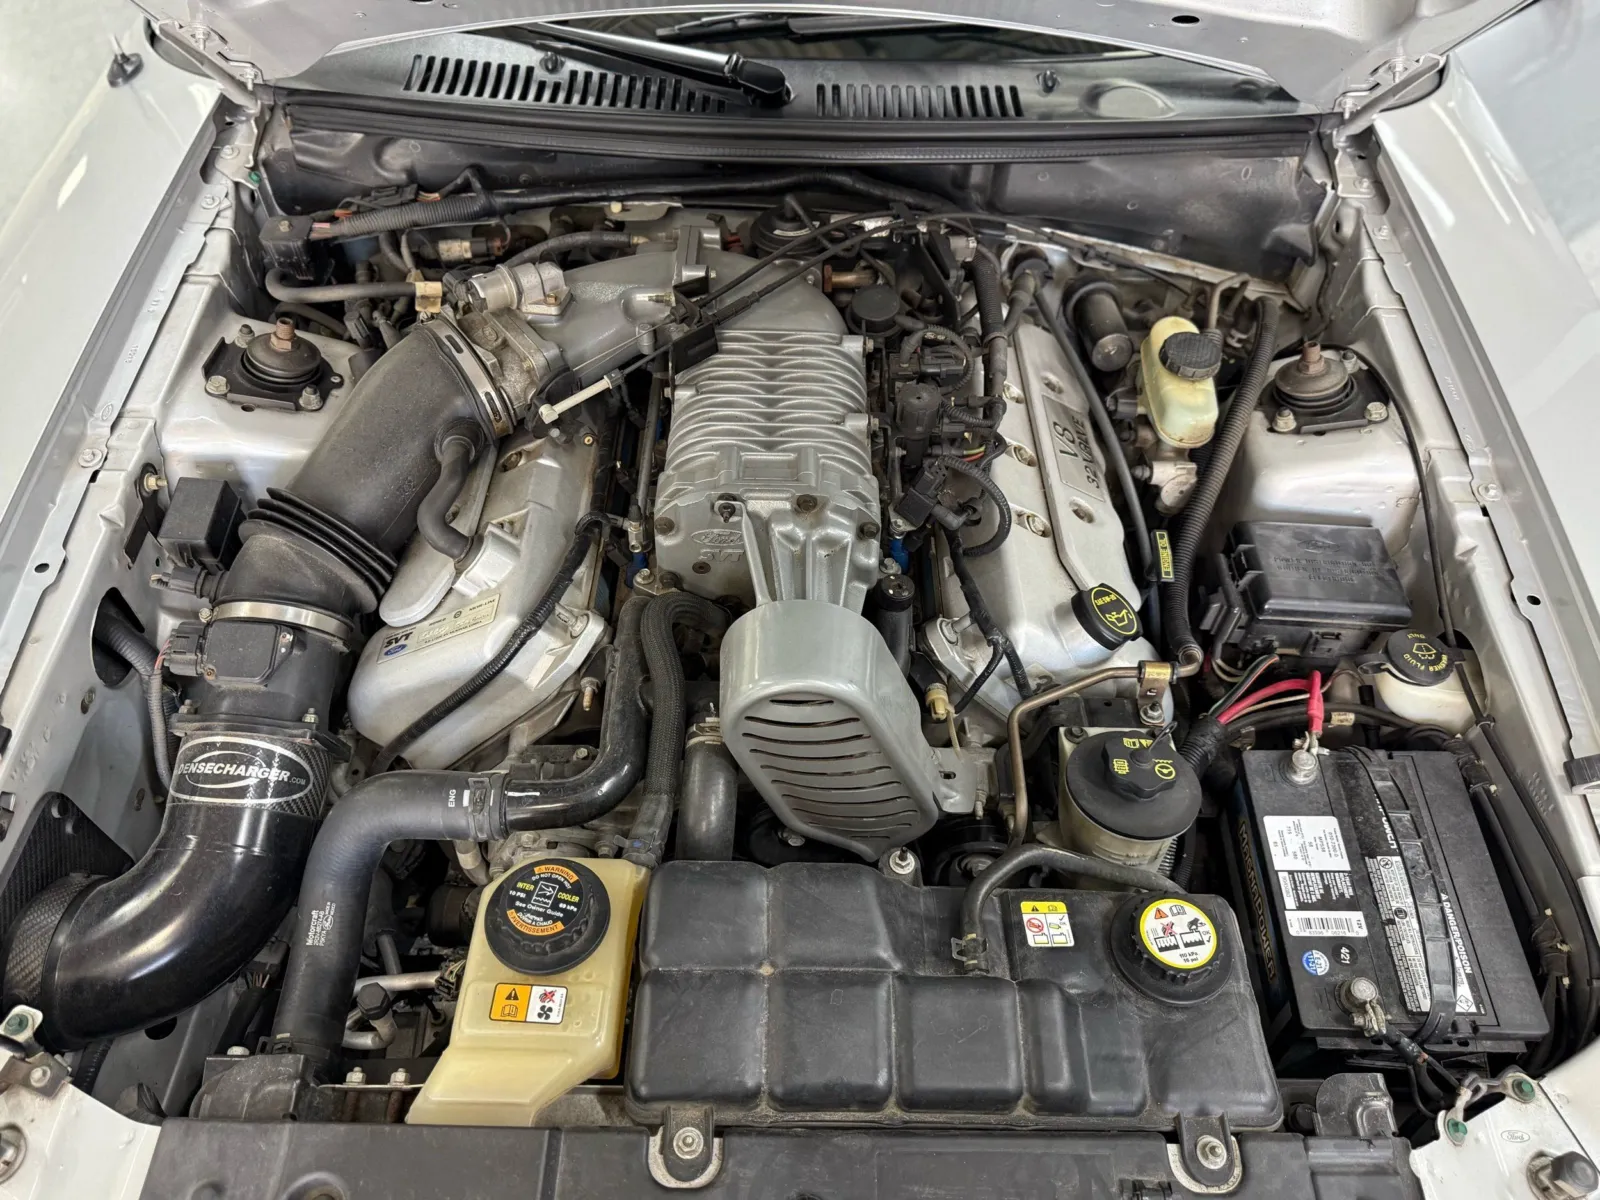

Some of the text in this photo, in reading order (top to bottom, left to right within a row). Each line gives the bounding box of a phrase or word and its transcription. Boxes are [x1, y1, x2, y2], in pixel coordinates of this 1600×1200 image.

[1053, 421, 1079, 458] V8
[384, 632, 413, 648] SVT
[448, 789, 457, 807] ENG
[544, 866, 574, 880] WARNING
[516, 882, 535, 892] INTER
[557, 892, 580, 903] COOLER
[527, 903, 545, 913] Owner
[546, 908, 564, 918] Guide
[305, 910, 320, 946] Motorcraft
[511, 914, 560, 933] AVERTISSEMENT
[1442, 901, 1473, 974] DANGER/POISON
[1340, 946, 1351, 964] 4/21
